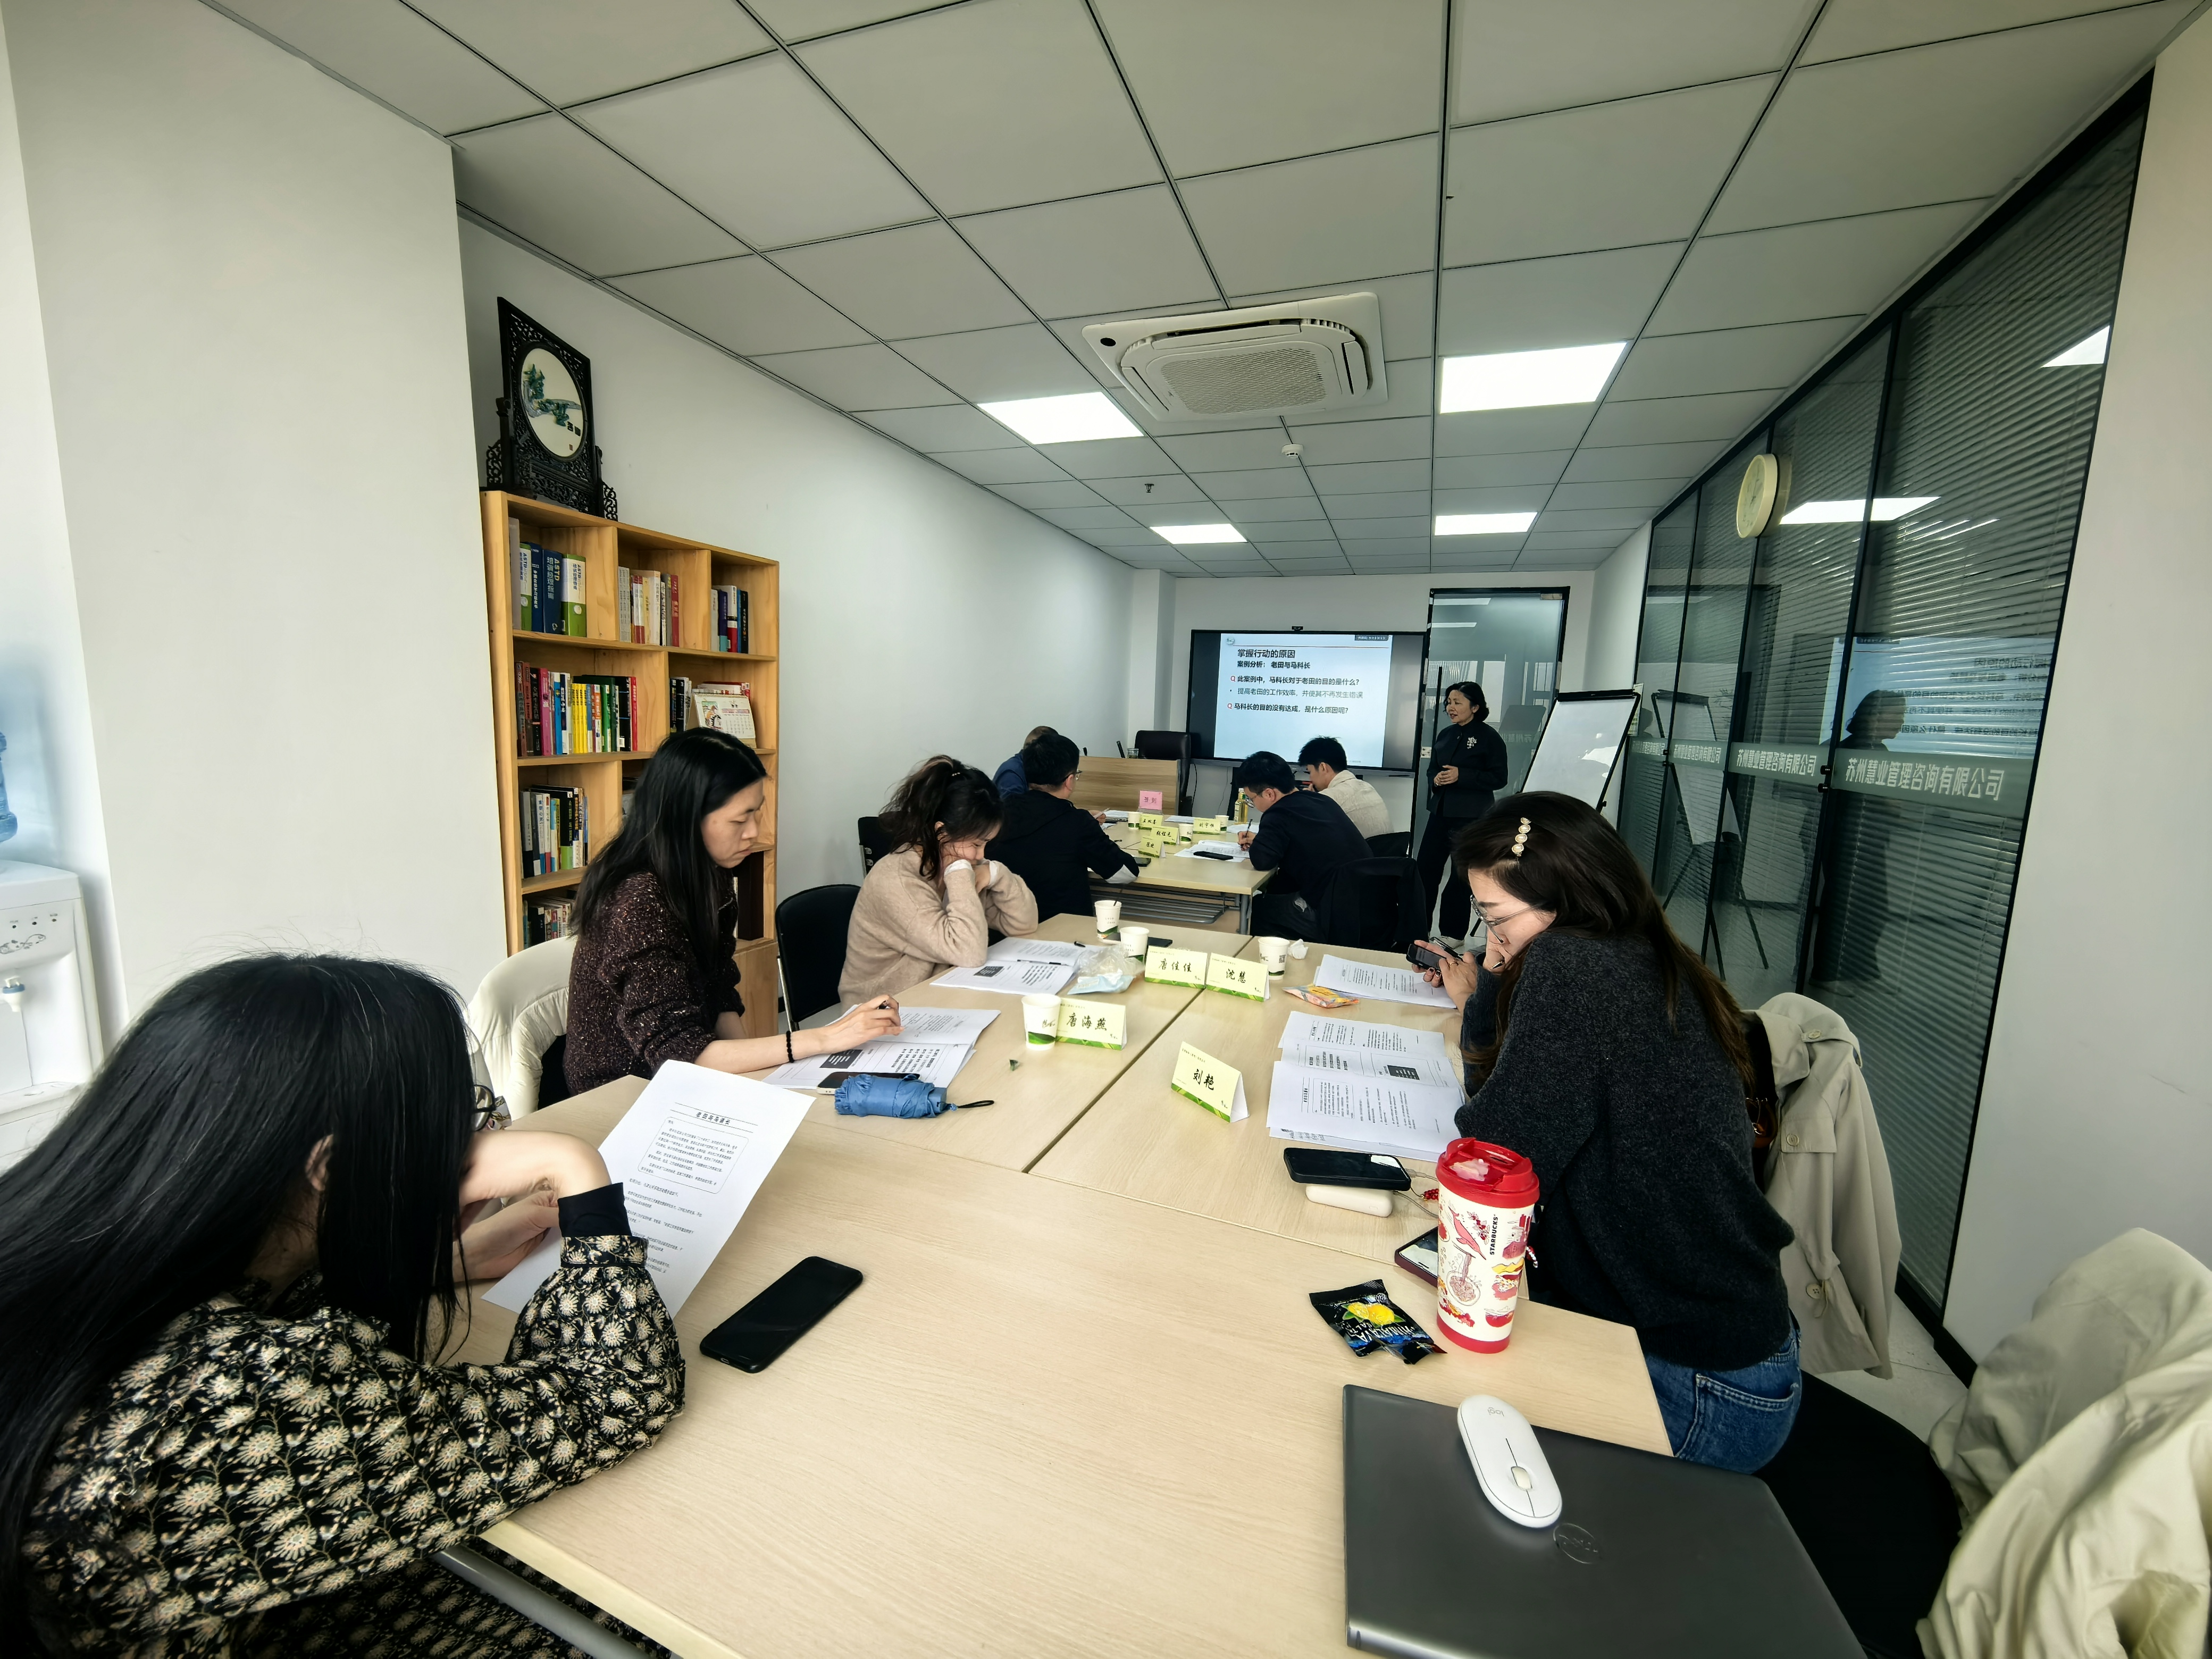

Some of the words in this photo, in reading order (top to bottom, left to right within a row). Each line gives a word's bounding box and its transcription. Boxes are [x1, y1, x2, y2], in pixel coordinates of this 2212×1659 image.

[1237, 649, 1296, 659] 掌握行动的原因
[1737, 749, 1817, 777] 苏州慧业管理咨询有限公司
[1846, 758, 2005, 801] 苏州慧业管理咨询有限公司
[1066, 1012, 1107, 1031] 唐海燕
[1489, 1216, 1498, 1255] STARBUCKS
[1487, 1406, 1504, 1417] logi
